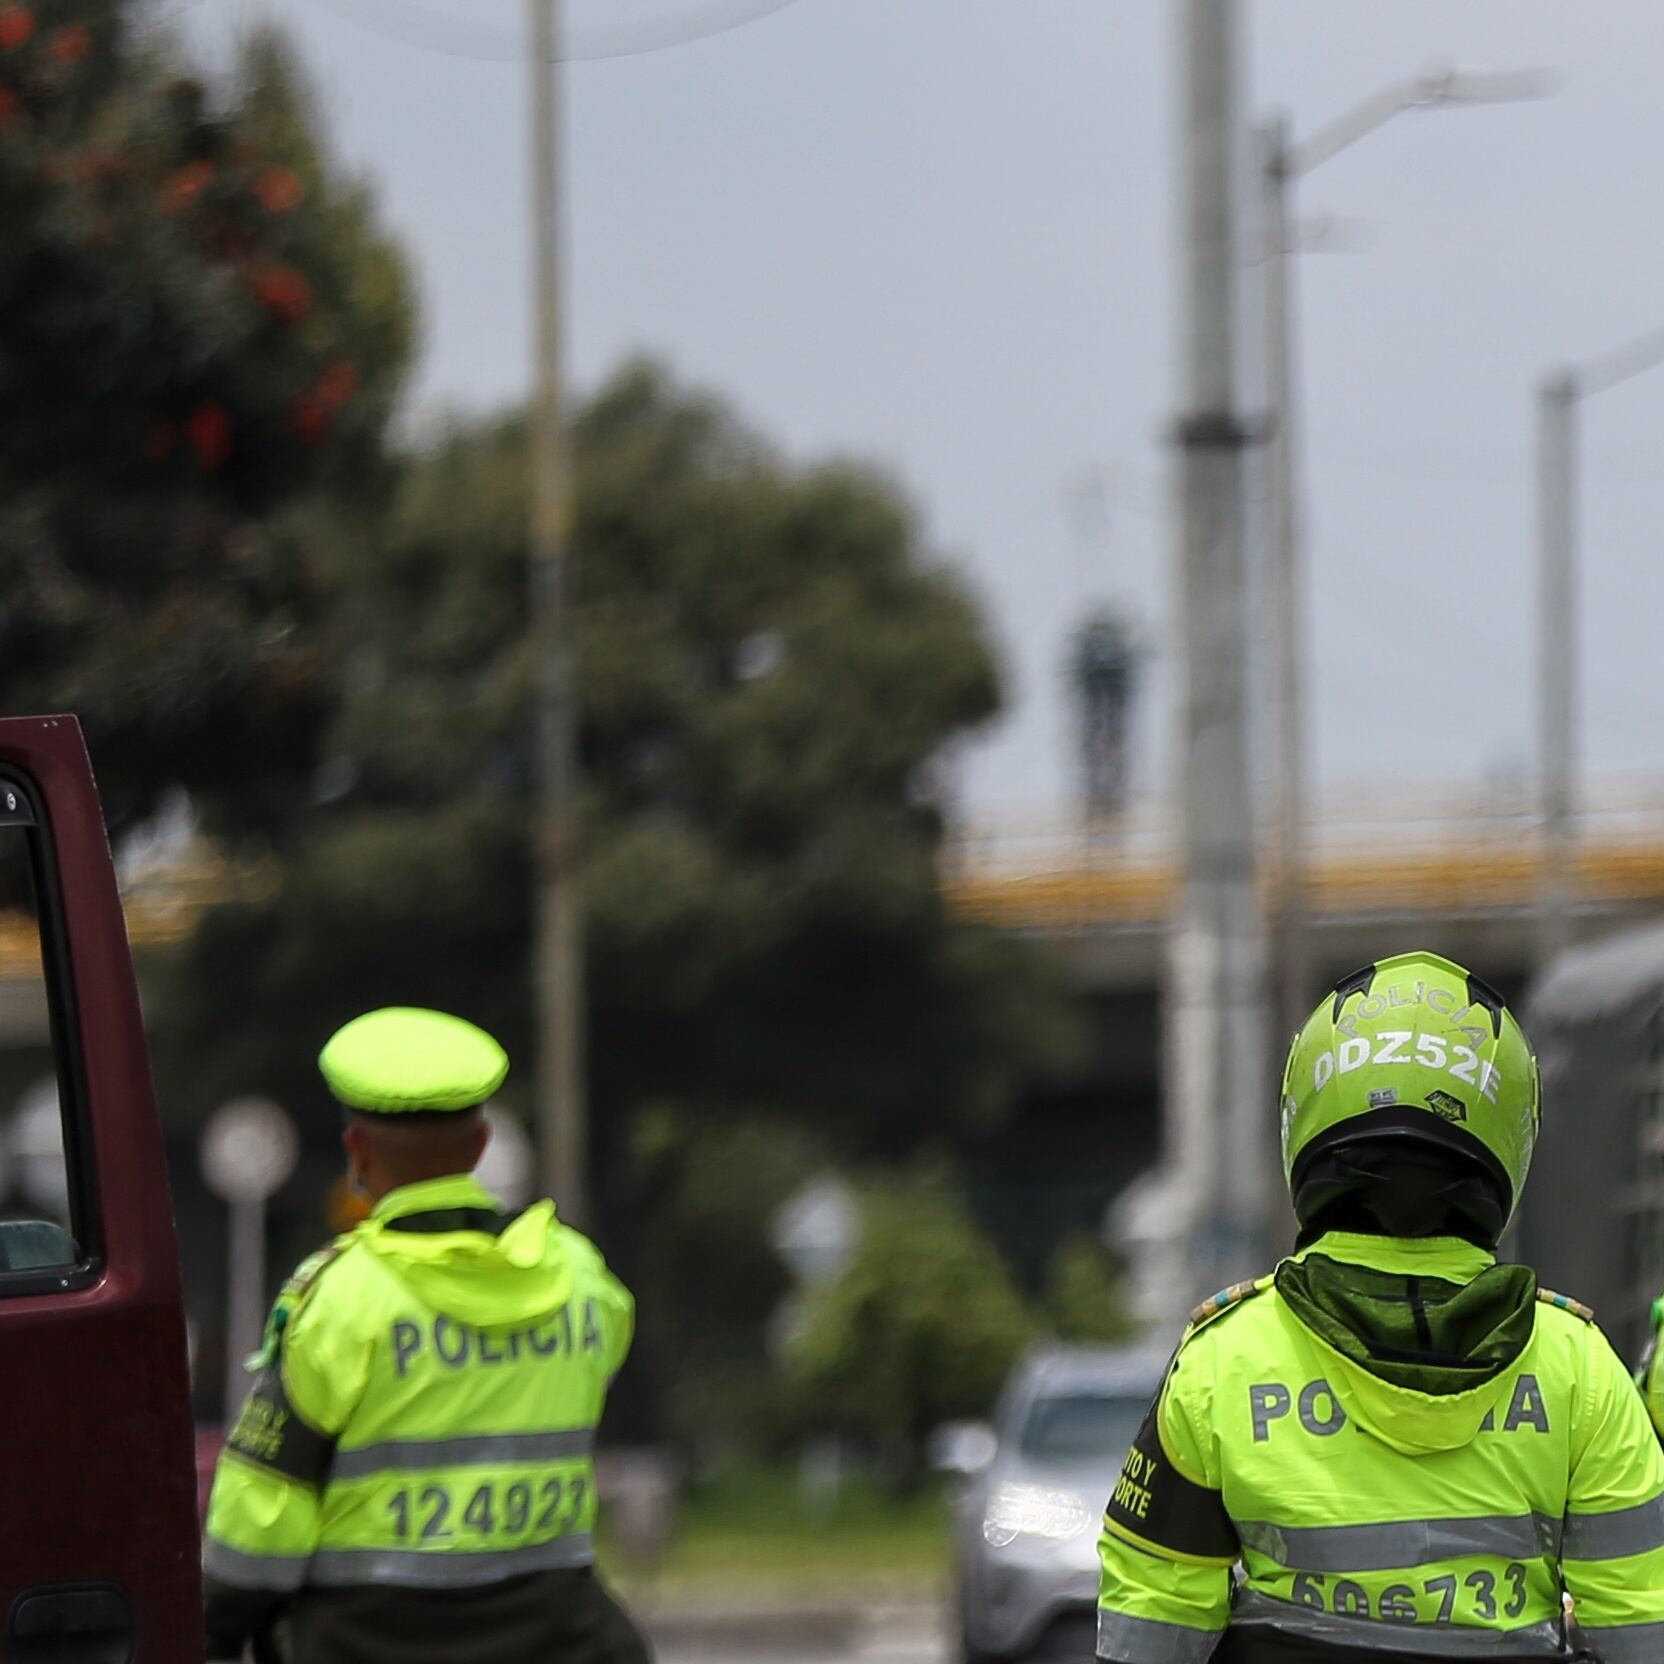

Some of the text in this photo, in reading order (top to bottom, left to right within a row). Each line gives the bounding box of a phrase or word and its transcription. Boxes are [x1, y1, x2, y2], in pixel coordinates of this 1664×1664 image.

[1336, 981, 1488, 1051] POLICIA
[1313, 1031, 1502, 1105] DDZ52E
[1143, 1459, 1157, 1487] Y
